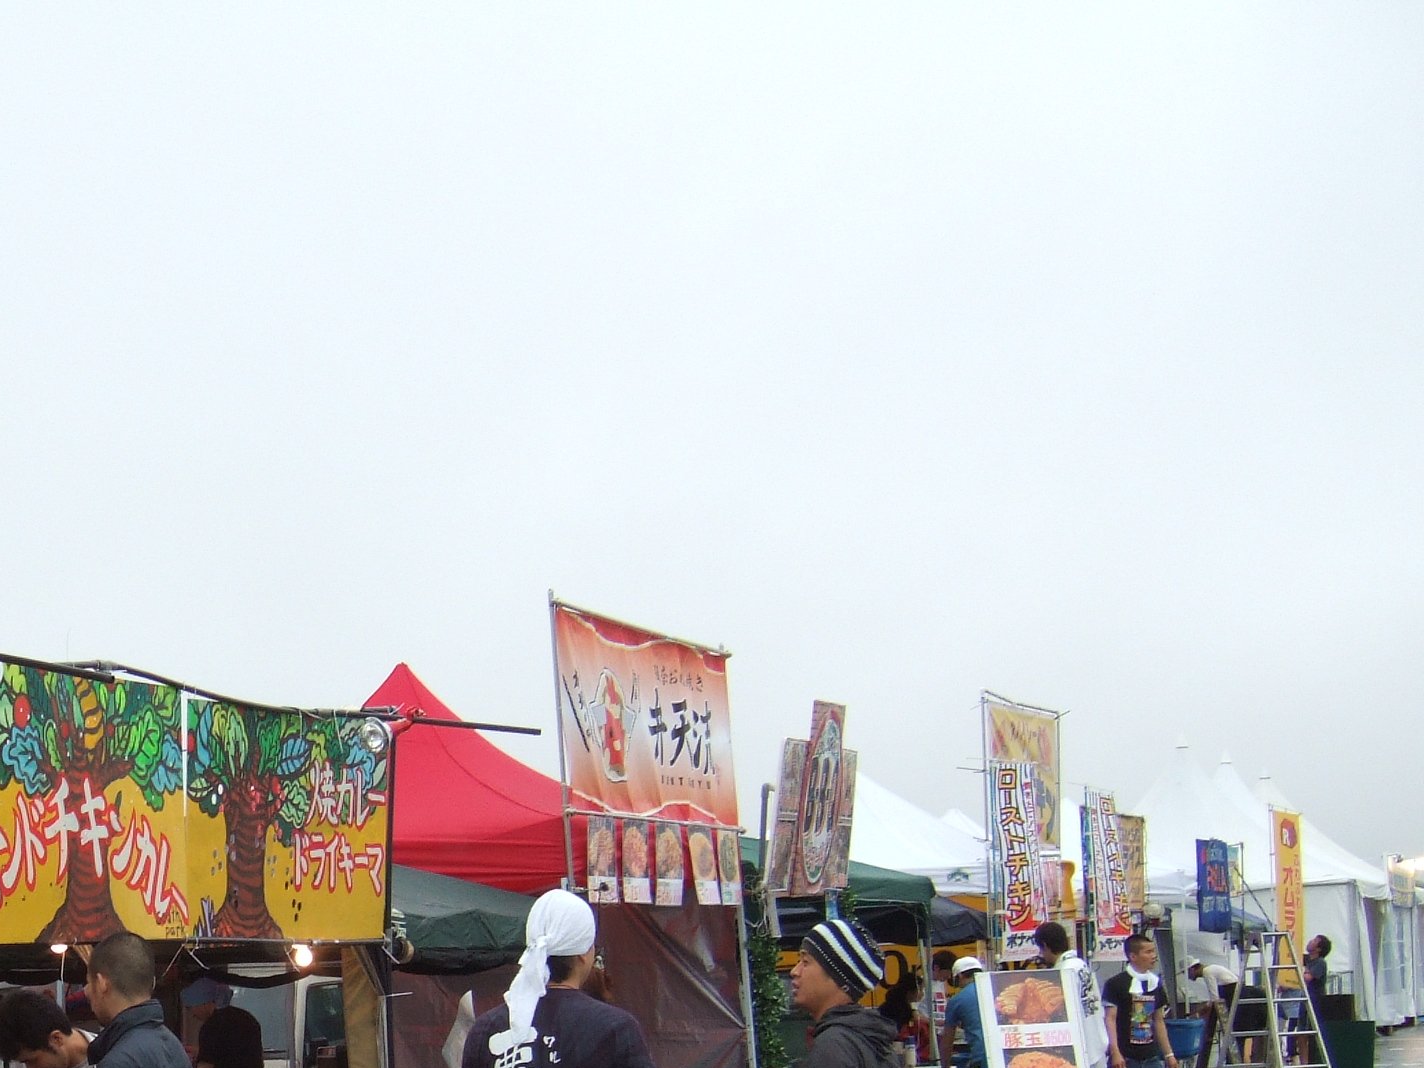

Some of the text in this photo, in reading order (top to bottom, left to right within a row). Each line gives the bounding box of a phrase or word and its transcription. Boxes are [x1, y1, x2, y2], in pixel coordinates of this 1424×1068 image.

[306, 760, 387, 832] 焼カレー
[292, 832, 385, 897] ドライキーマ
[996, 768, 1032, 928] ローストチキン
